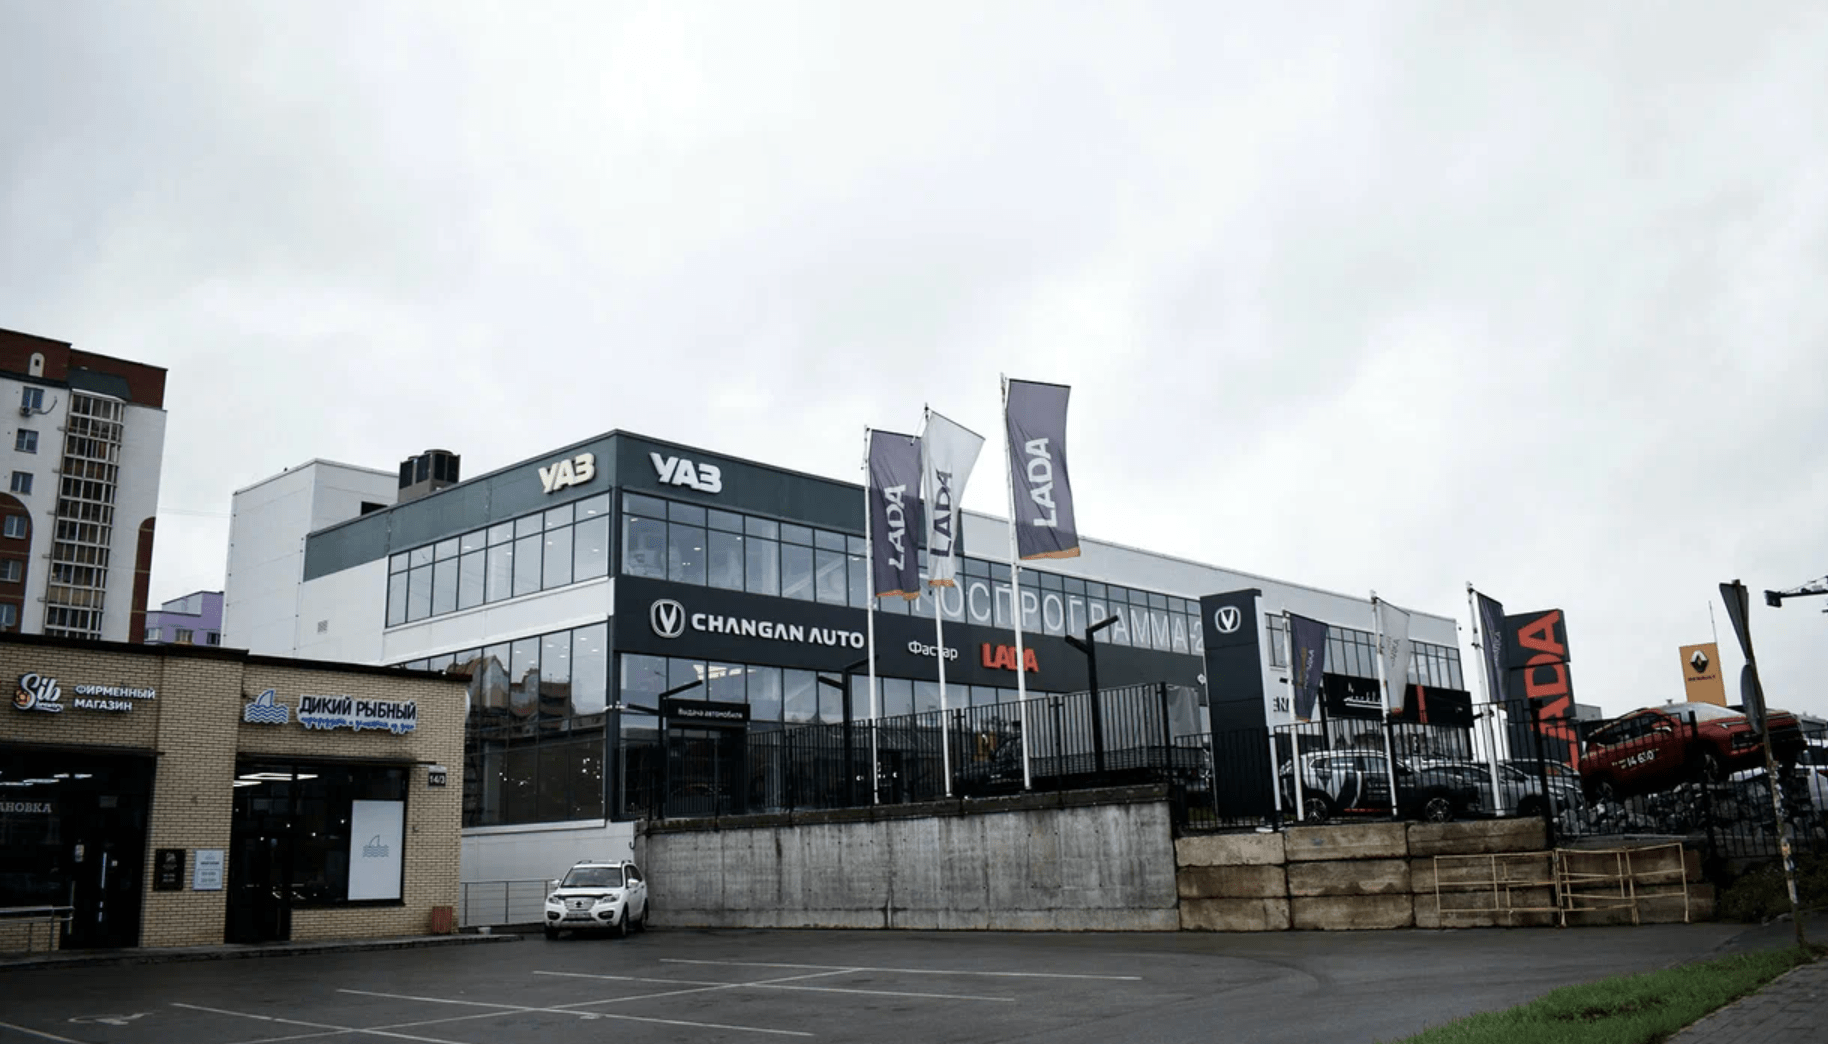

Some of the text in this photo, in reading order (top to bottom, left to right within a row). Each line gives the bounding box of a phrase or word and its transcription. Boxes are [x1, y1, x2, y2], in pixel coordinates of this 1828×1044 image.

[538, 452, 595, 493] УАЗ
[650, 452, 722, 493] УАЗ
[1025, 437, 1058, 527] LADA
[883, 484, 906, 571] LADA
[930, 468, 953, 557] LADA
[691, 613, 865, 649] CHANGAN AUTO
[908, 640, 958, 661] Фасар
[13, 673, 61, 710] Sib
[74, 699, 133, 711] МАГАЗИН
[75, 684, 156, 699] ФИРМЕННЫЙ
[300, 696, 416, 720] ДИКИЙ РЫБНЫЙ
